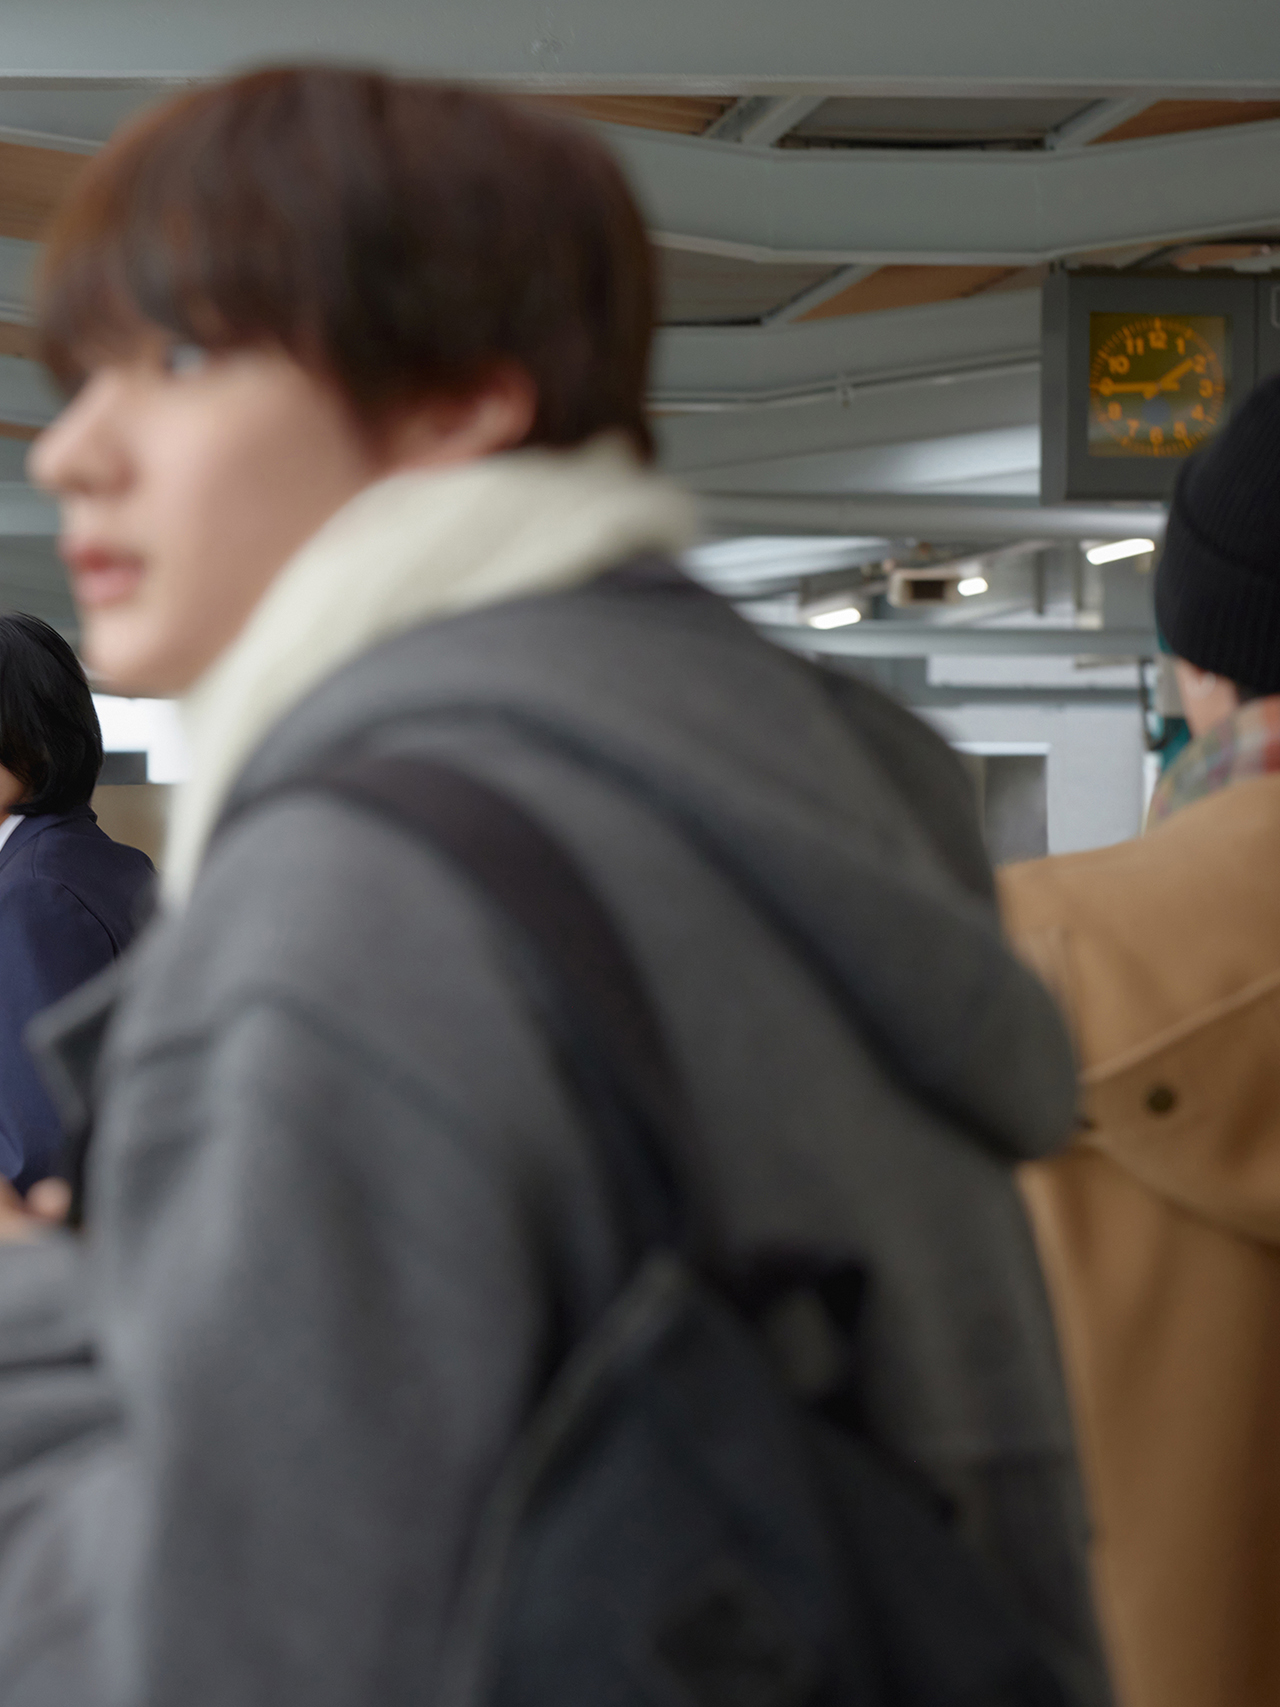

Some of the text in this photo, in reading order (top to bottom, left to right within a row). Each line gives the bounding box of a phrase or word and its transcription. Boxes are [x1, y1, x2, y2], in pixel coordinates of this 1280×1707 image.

[1126, 336, 1144, 356] 11
[1148, 331, 1168, 350] 12
[1175, 336, 1186, 355] 1
[1108, 354, 1130, 375] 10
[1193, 354, 1207, 374] 2
[1199, 378, 1214, 399] 3
[1191, 403, 1205, 422] 4
[1127, 418, 1140, 438] 7
[1149, 426, 1164, 445] 6
[1173, 420, 1187, 439] 5
